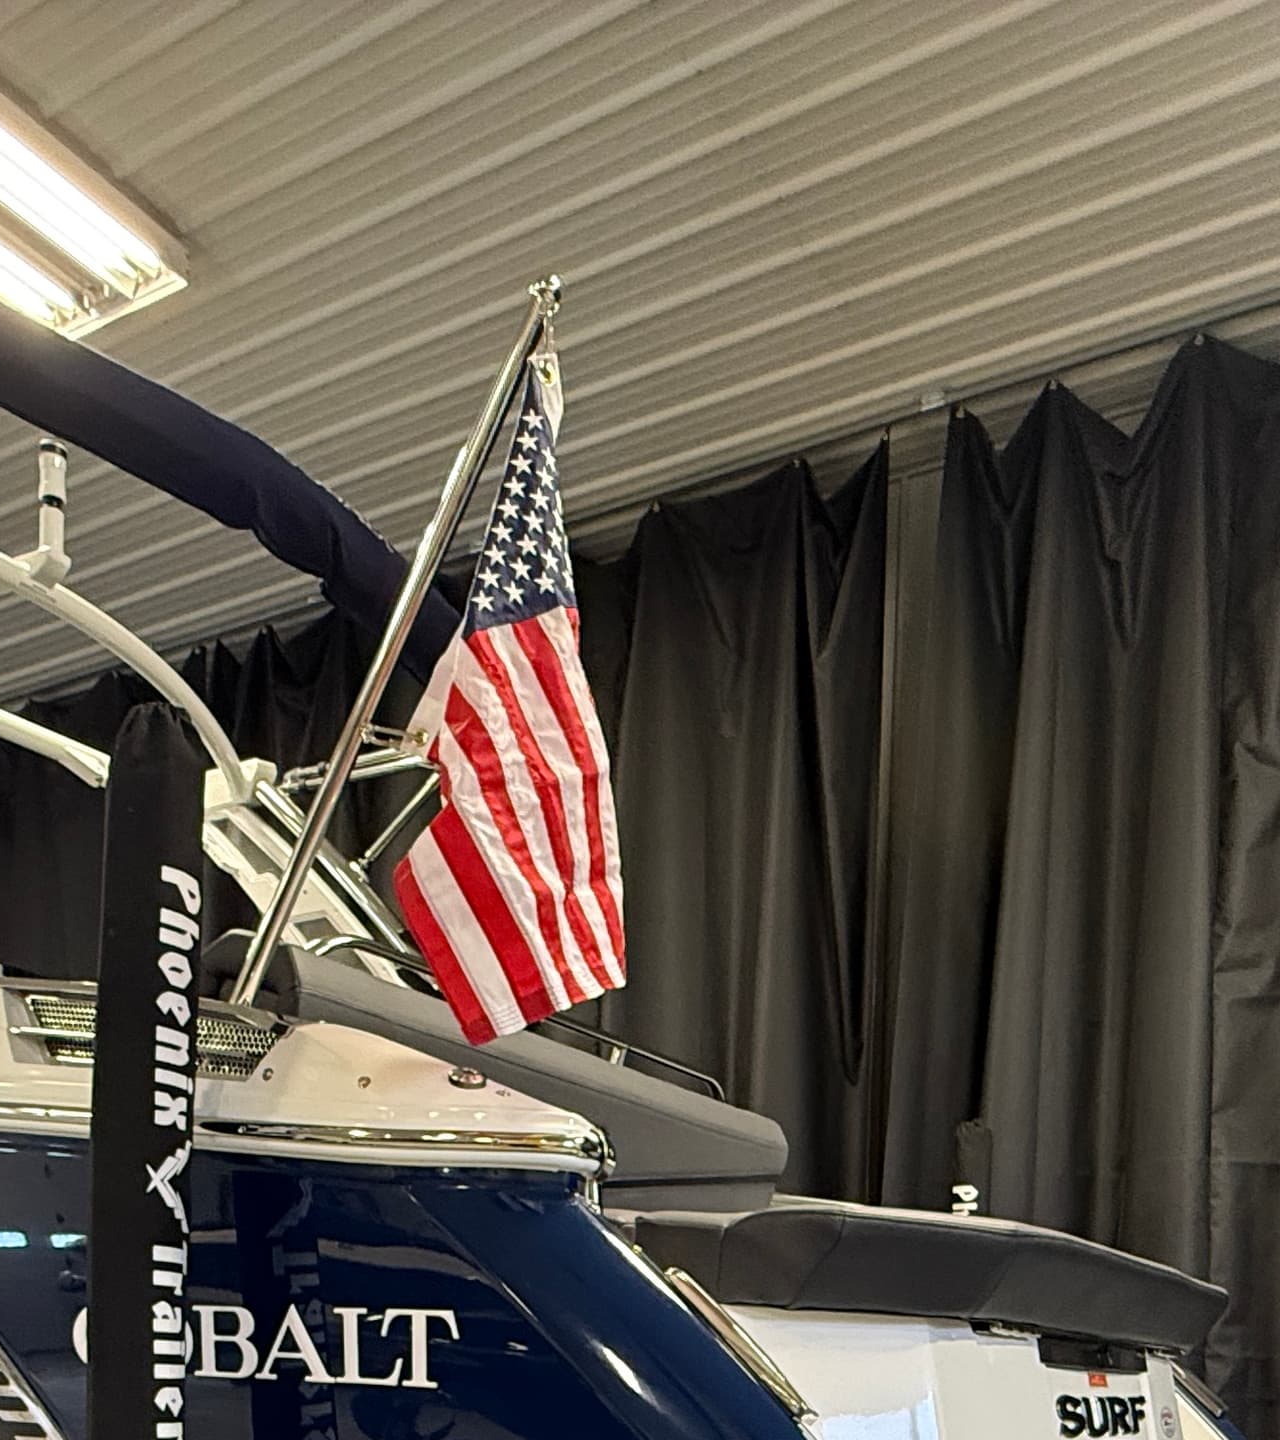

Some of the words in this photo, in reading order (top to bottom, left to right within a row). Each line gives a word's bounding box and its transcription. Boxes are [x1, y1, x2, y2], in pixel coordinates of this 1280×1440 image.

[154, 864, 202, 1131] Phoenix
[73, 1303, 460, 1389] BALT
[1056, 1393, 1147, 1439] SURF
